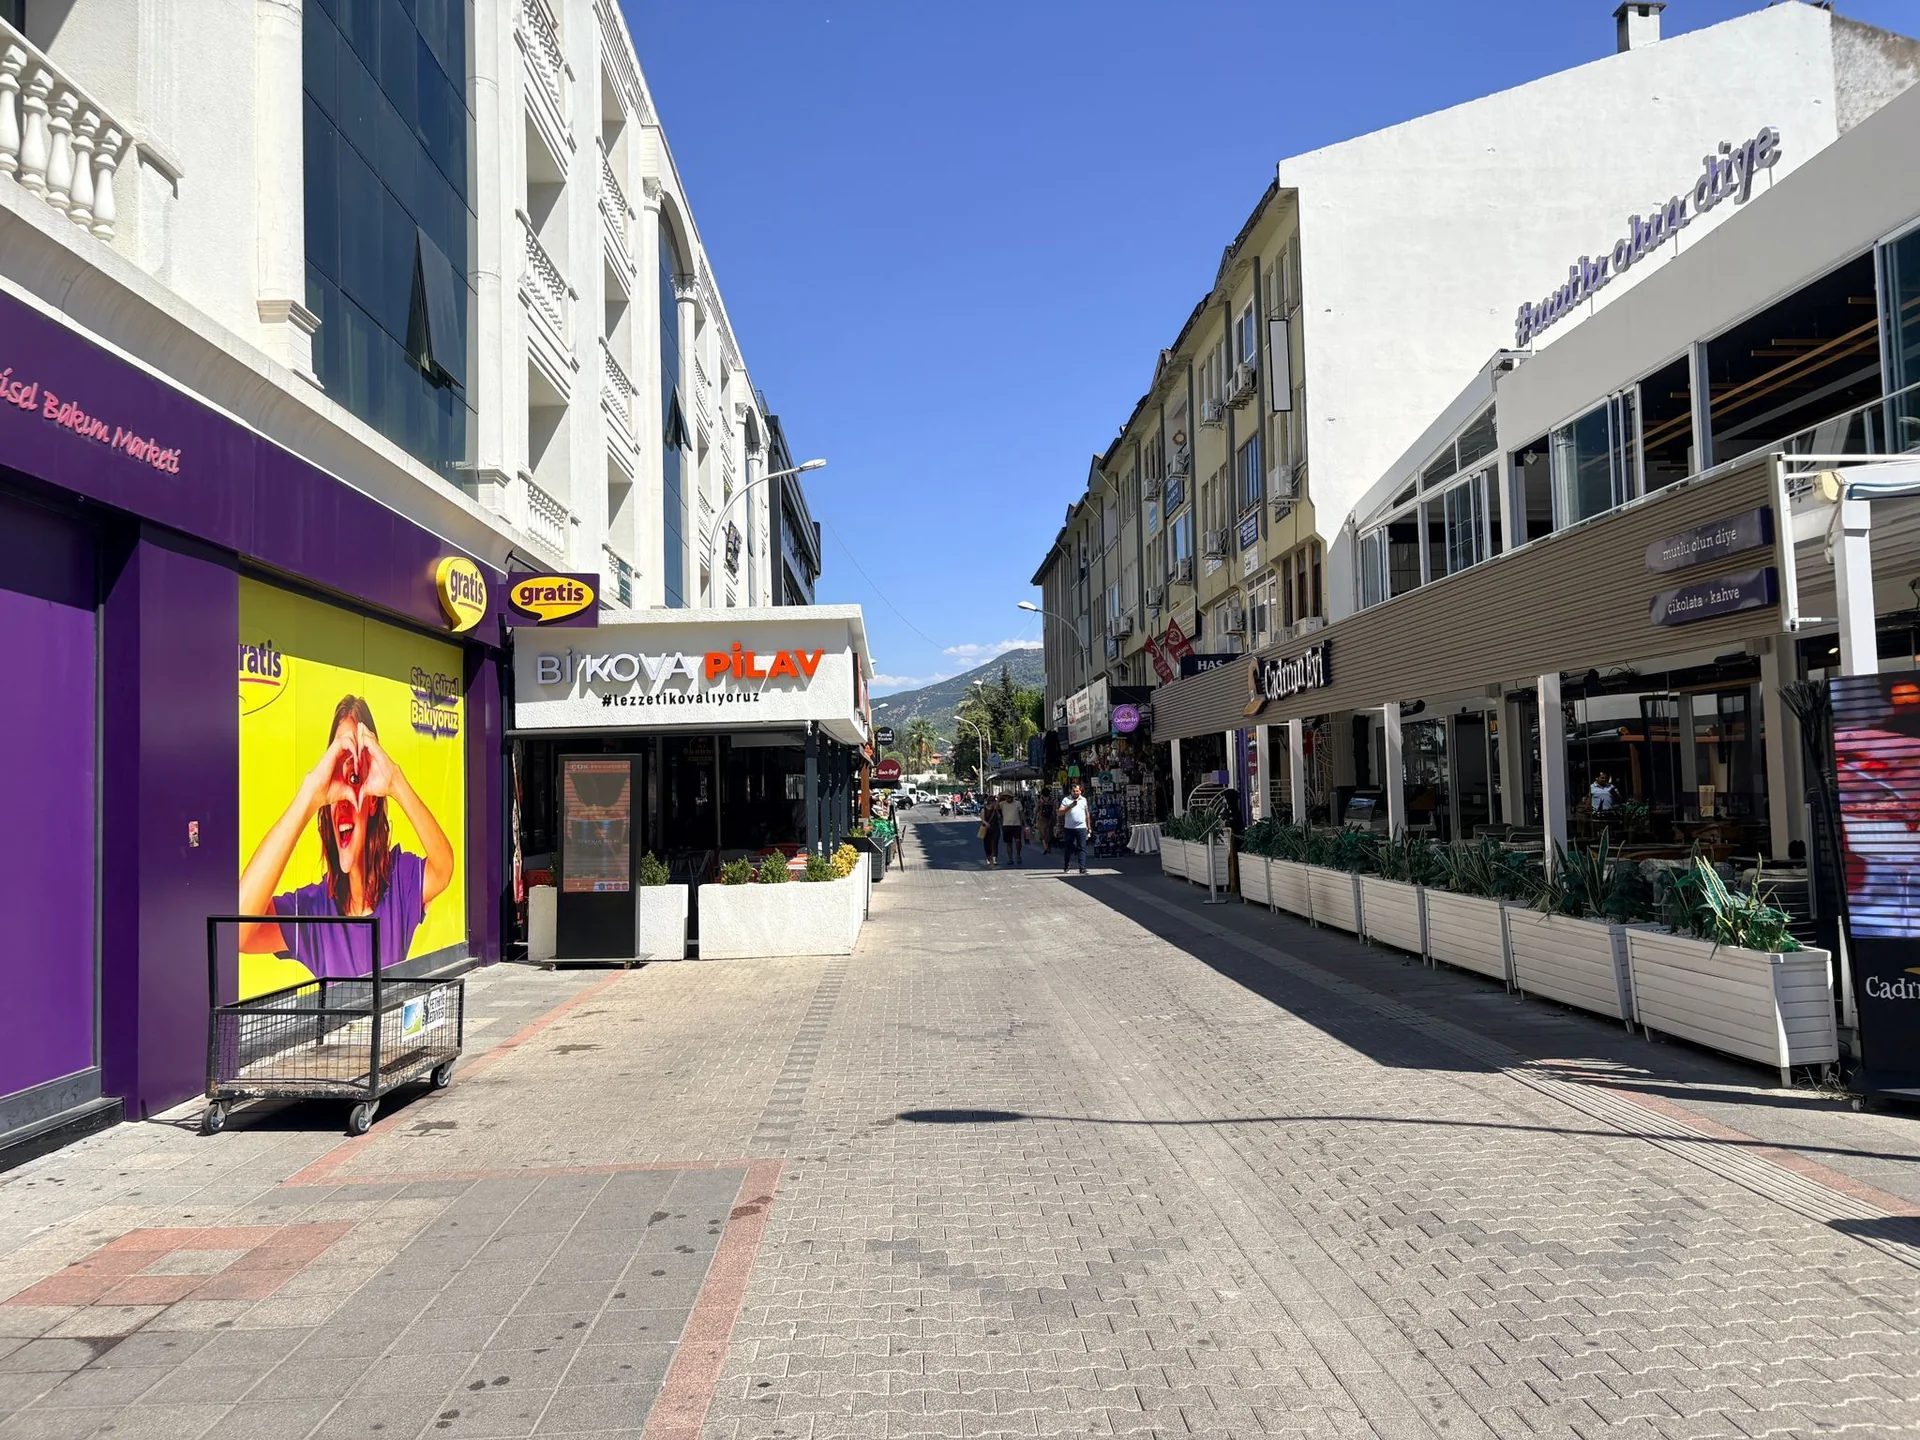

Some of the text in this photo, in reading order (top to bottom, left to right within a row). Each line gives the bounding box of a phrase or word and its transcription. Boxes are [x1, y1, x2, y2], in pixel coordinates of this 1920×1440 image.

[1515, 125, 1782, 348] #mutlu olun diye
[0, 367, 181, 474] isel Bakım Marketi
[1662, 528, 1738, 560] mutlu olun diye
[450, 567, 484, 605] gratis
[519, 582, 585, 606] gratis
[1667, 594, 1703, 615] çikolata
[1709, 587, 1740, 604] kahve
[239, 639, 282, 678] ratis
[704, 641, 825, 681] PİLAV
[1197, 659, 1223, 671] HAS
[1305, 640, 1325, 689] Evi
[410, 667, 459, 701] Size Güzel
[602, 691, 760, 707] #lezzetikovalıyoruz
[411, 700, 459, 734] Bakıyoruz
